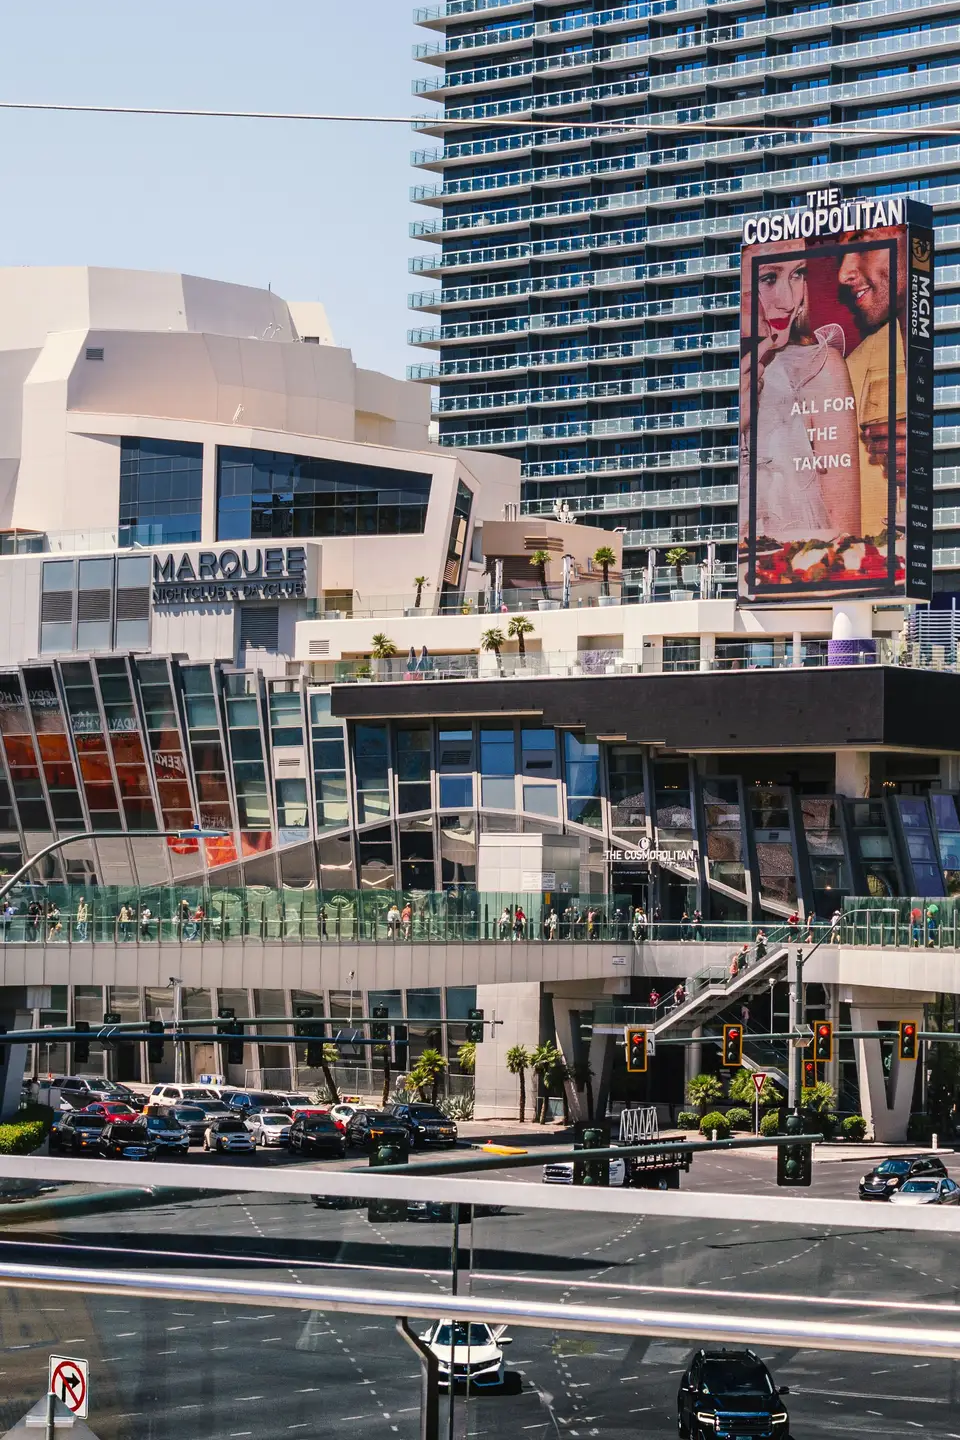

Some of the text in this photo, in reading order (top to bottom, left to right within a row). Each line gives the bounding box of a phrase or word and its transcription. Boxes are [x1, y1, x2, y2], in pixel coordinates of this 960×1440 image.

[806, 188, 839, 209] THE
[744, 198, 904, 245] COSMOPOLITAN
[918, 276, 931, 339] MGM
[791, 396, 855, 416] ALL FOR
[807, 426, 838, 442] THE
[793, 453, 852, 471] TAKING
[153, 546, 305, 579] MARQUEE
[152, 581, 305, 602] NIGHTCLUB & DAYCLUB
[605, 849, 694, 861] THE COSMOPOLITAN
